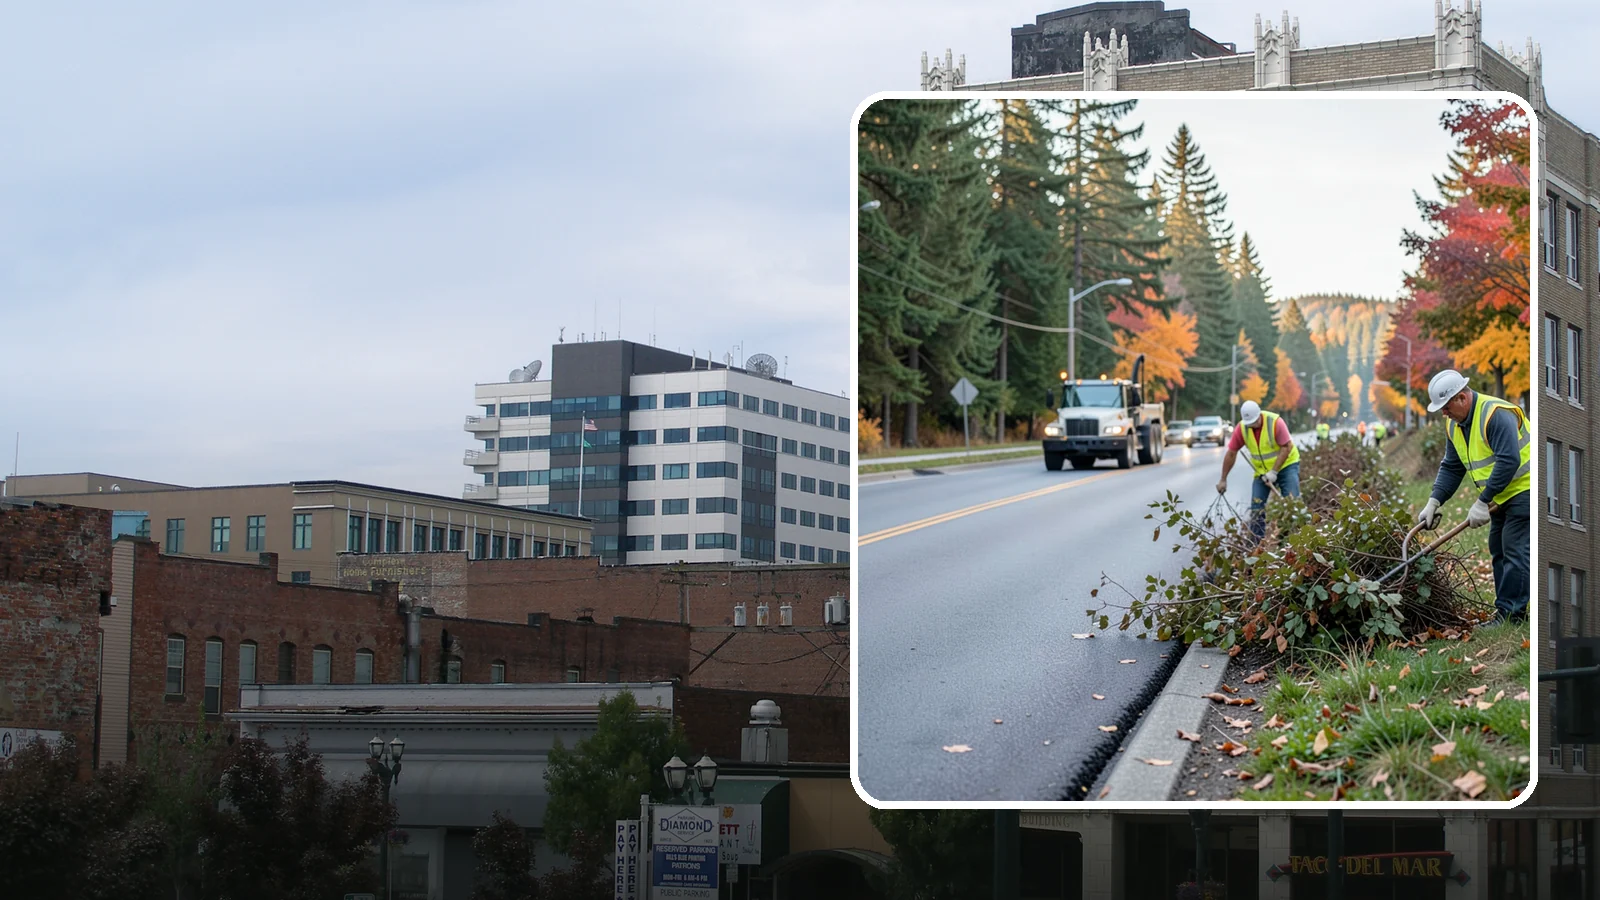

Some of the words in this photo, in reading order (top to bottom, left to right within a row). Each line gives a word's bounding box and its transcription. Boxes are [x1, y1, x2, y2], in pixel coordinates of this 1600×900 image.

[343, 568, 367, 577] Home
[370, 566, 428, 576] Furnishers
[660, 818, 713, 832] DIAMOND
[1022, 815, 1071, 828] BUILDING
[617, 825, 625, 852] PAY
[628, 824, 637, 852] PAY
[656, 845, 688, 853] RESERVED
[689, 846, 716, 854] PARKING
[721, 851, 739, 863] Soup
[671, 862, 701, 870] PATRONS
[1346, 856, 1385, 875] DEL
[1392, 857, 1443, 877] MAR
[616, 856, 625, 893] HERE
[627, 856, 636, 893] HERE
[660, 888, 682, 897] PUBLIC
[683, 889, 710, 898] PARKING
